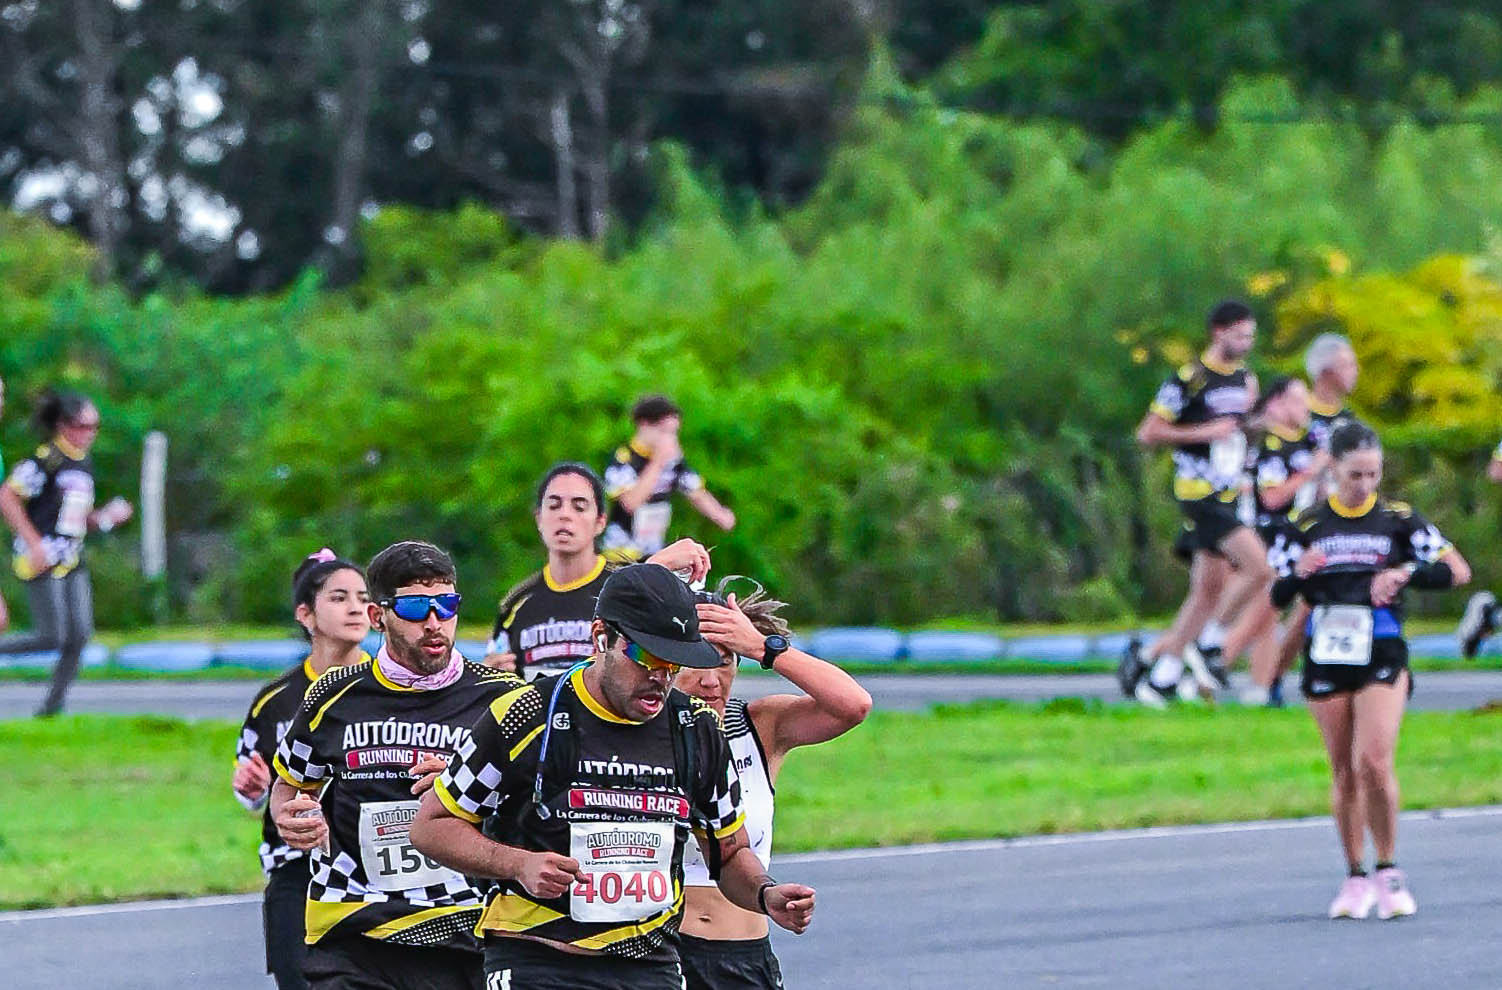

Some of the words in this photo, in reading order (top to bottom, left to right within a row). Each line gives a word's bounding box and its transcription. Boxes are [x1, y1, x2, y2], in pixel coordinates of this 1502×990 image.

[359, 749, 414, 766] RUNNING
[374, 770, 385, 779] de
[386, 770, 397, 779] los
[583, 791, 643, 810] RUNNING
[647, 796, 681, 815] RACE
[556, 809, 567, 819] La
[568, 810, 600, 820] Carrera
[601, 813, 612, 821] de
[587, 827, 661, 848] AUTÓDROMO
[573, 870, 667, 904] 4040
